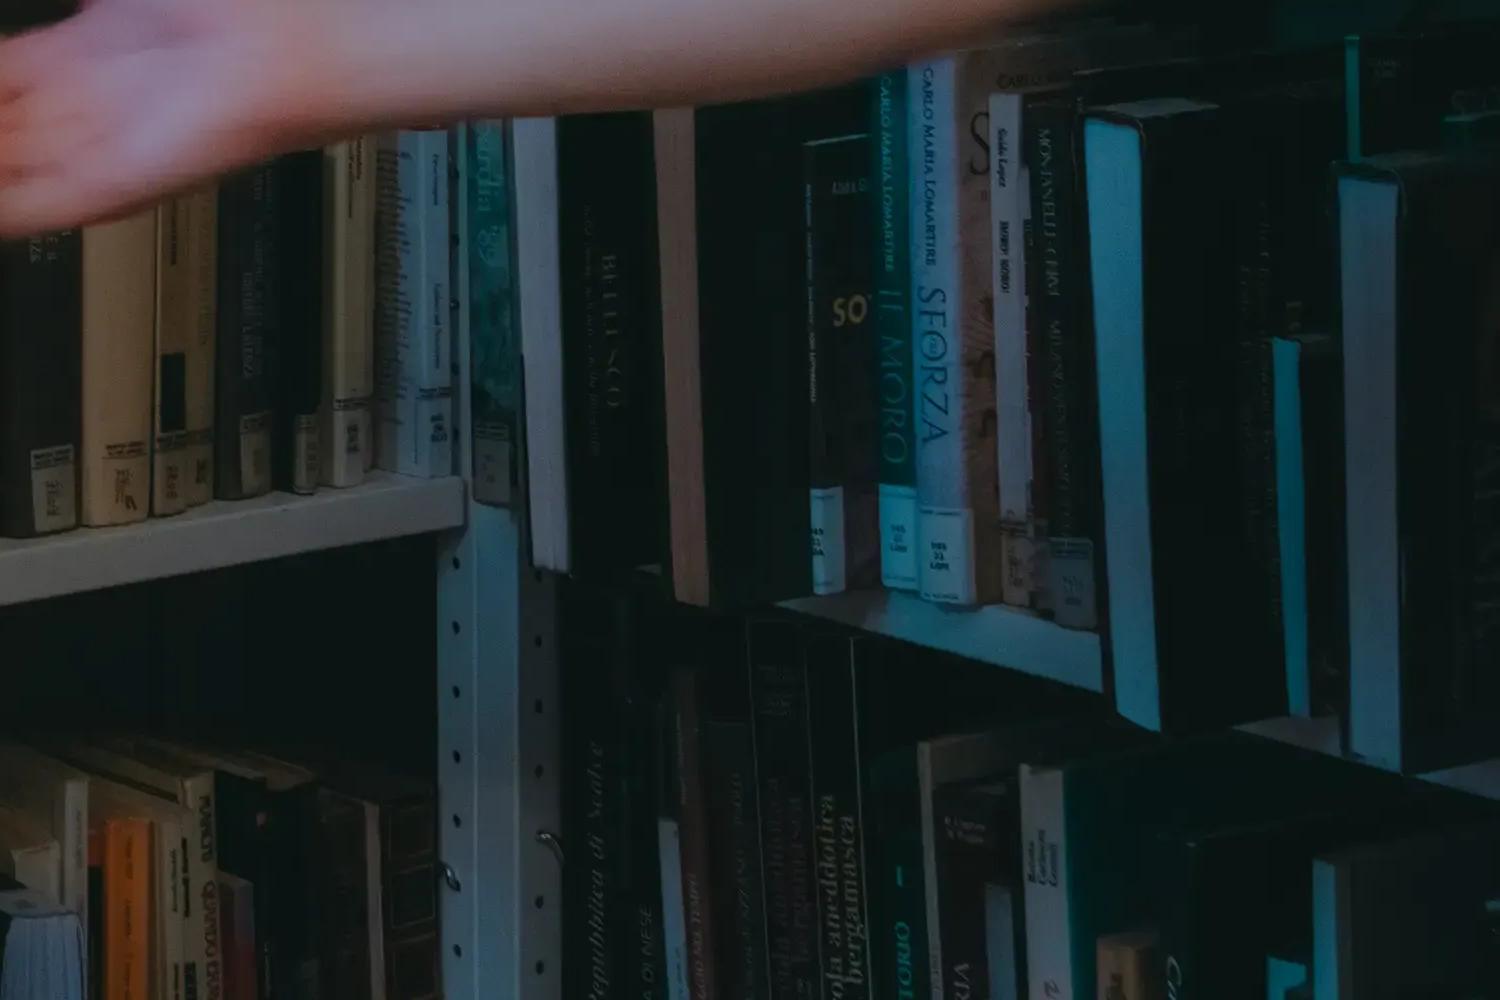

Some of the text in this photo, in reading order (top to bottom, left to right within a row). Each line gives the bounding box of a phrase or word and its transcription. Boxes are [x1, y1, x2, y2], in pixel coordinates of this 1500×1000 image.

[996, 128, 1007, 156] Guido
[877, 75, 907, 464] CARLO MARIA LOMARTIRE IL MORO
[916, 67, 949, 444] CARLO MARIA LOMARTIRE SFORZA
[588, 831, 607, 860] di
[816, 794, 844, 949] aneddotica
[840, 814, 868, 985] bergamasca
[640, 903, 655, 983] DI NESE
[893, 921, 914, 1000] TORIO
